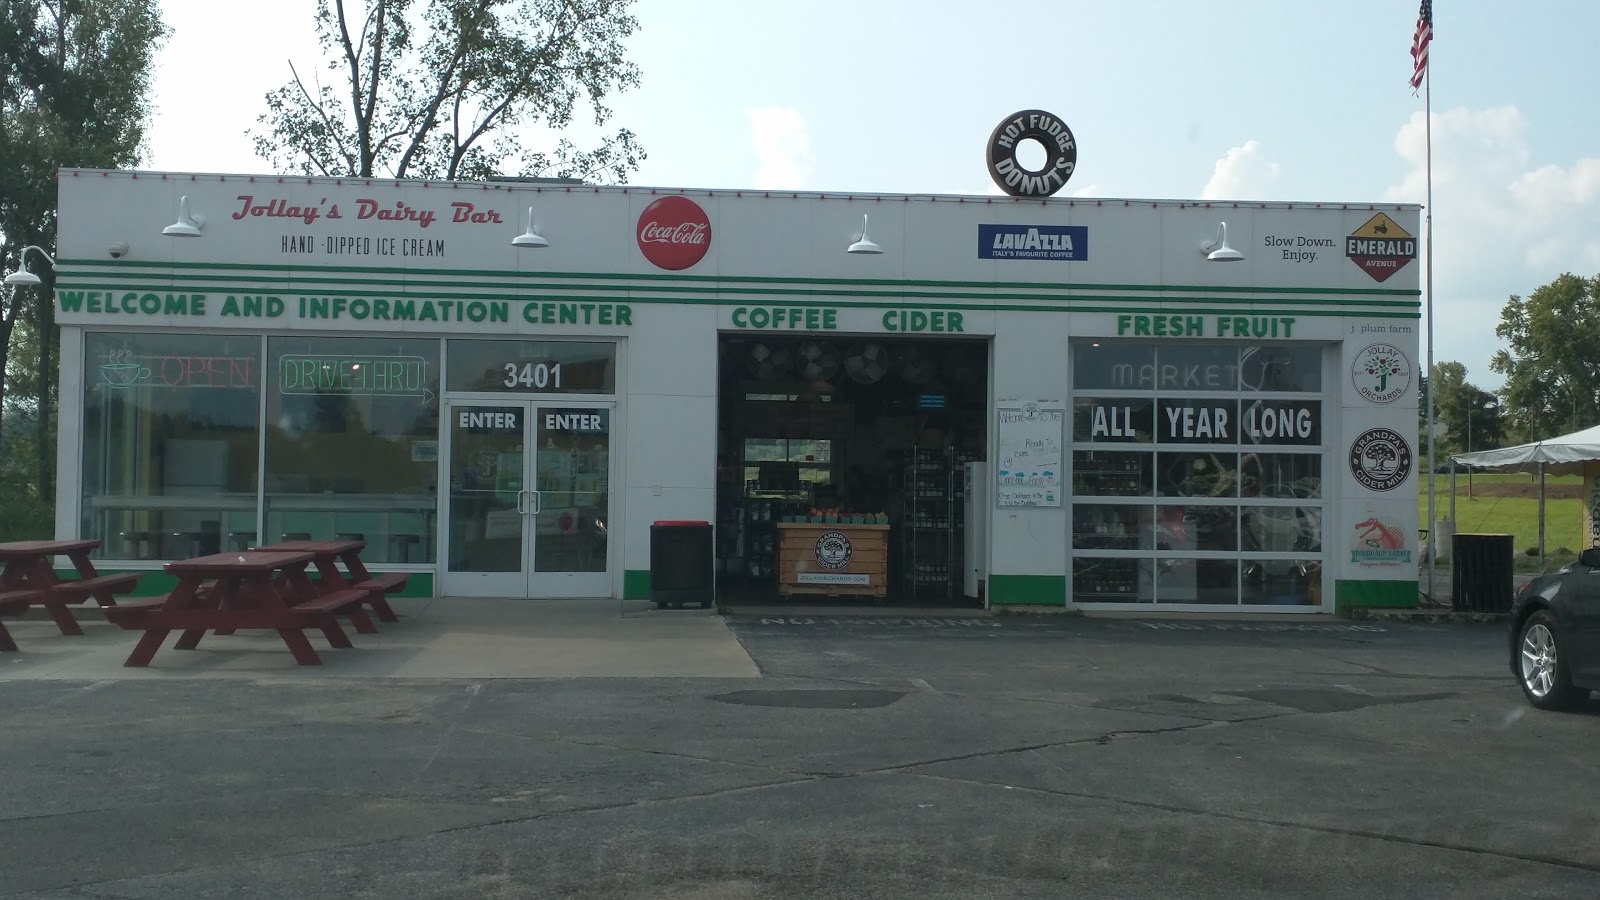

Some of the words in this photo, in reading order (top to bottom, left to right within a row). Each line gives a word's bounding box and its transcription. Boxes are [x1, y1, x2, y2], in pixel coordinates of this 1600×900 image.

[998, 116, 1025, 149] HOT
[1029, 114, 1074, 153] FUDGE
[994, 157, 1075, 195] DONUTS
[232, 195, 343, 225] Jollay's
[356, 199, 437, 228] Dairy
[451, 202, 504, 224] Bar
[281, 235, 314, 253] HAND
[376, 237, 396, 256] ICE
[402, 238, 445, 257] CREAM
[992, 228, 1073, 250] LAVAZZA
[1264, 235, 1294, 247] Slow
[1296, 236, 1336, 247] Down.
[1348, 239, 1415, 256] EMERALD
[1282, 249, 1319, 263] Enjoy.
[1365, 260, 1397, 268] AVENUE
[59, 290, 207, 316] WELCOME
[220, 295, 285, 318] AND
[299, 297, 508, 322] INFORMATION
[523, 302, 633, 326] CENTER
[732, 307, 837, 330] COFFEE
[882, 310, 964, 332] CIDER
[1117, 315, 1203, 337] FRESH
[1217, 317, 1296, 338] FRUIT
[1361, 323, 1386, 334] plum
[1389, 324, 1412, 334] farm
[1367, 347, 1399, 358] JOLLAY
[160, 356, 251, 388] OPEN
[284, 358, 420, 390] DRIVE-THRU
[503, 362, 561, 389] 3401
[1113, 363, 1239, 387] MARKET
[1361, 386, 1402, 402] ORCHARDS
[459, 412, 516, 429] ENTER
[545, 414, 602, 430] ENTER
[1092, 406, 1136, 437] ALL
[1165, 407, 1229, 439] YEAR
[1250, 407, 1312, 439] LONG
[1355, 431, 1406, 455] GRANDPA'S
[1356, 469, 1385, 489] CIDER
[1386, 469, 1407, 487] MILL
[817, 556, 836, 570] CIDER
[836, 556, 850, 568] MILL
